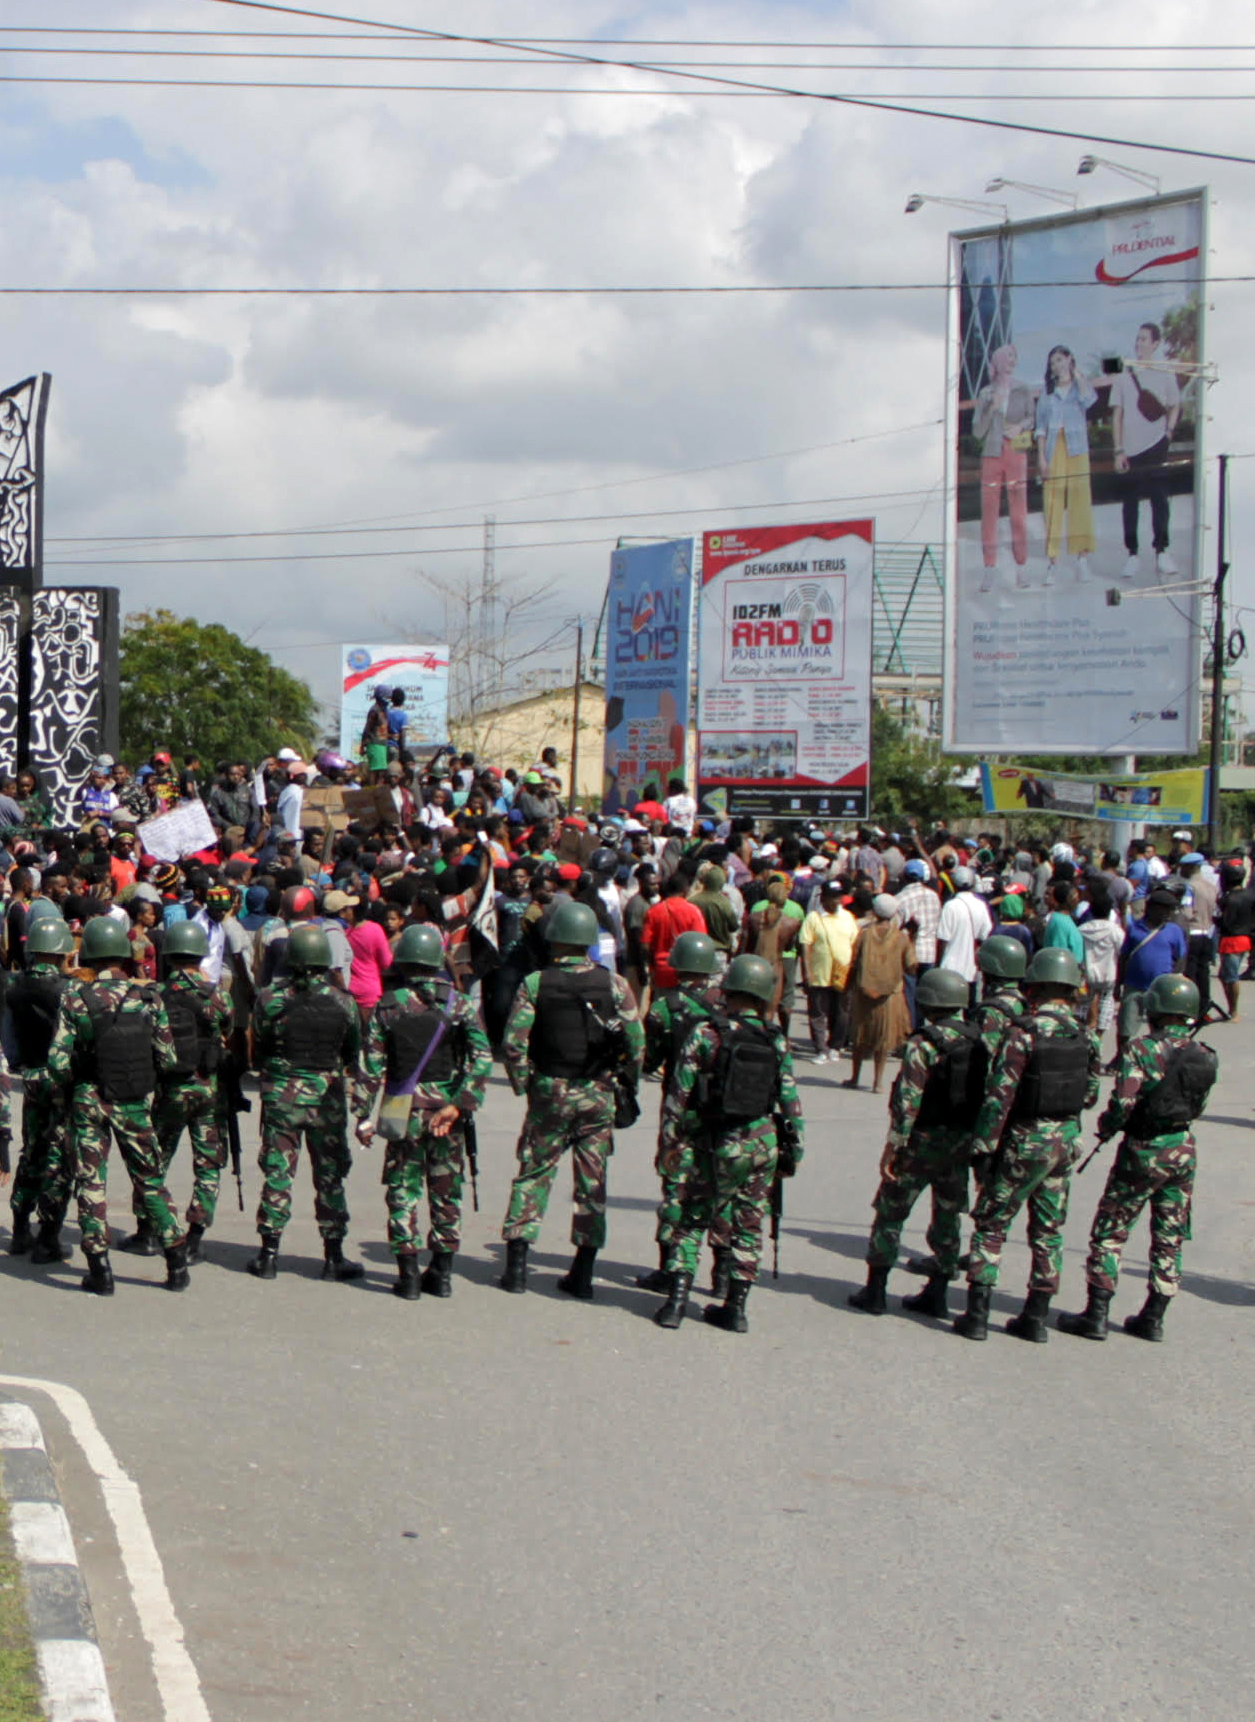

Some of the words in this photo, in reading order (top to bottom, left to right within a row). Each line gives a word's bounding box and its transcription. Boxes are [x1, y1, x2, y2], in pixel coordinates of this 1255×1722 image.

[1112, 235, 1175, 256] PRUDENTIAL
[744, 562, 807, 576] DENGARKAN
[812, 559, 846, 571] TERUS
[616, 583, 680, 629] HANI
[732, 603, 782, 620] 102FM
[731, 618, 833, 648] RADIO
[615, 625, 680, 663] 2019
[731, 648, 776, 660] PUBLIK
[780, 645, 832, 659] MIMIKA
